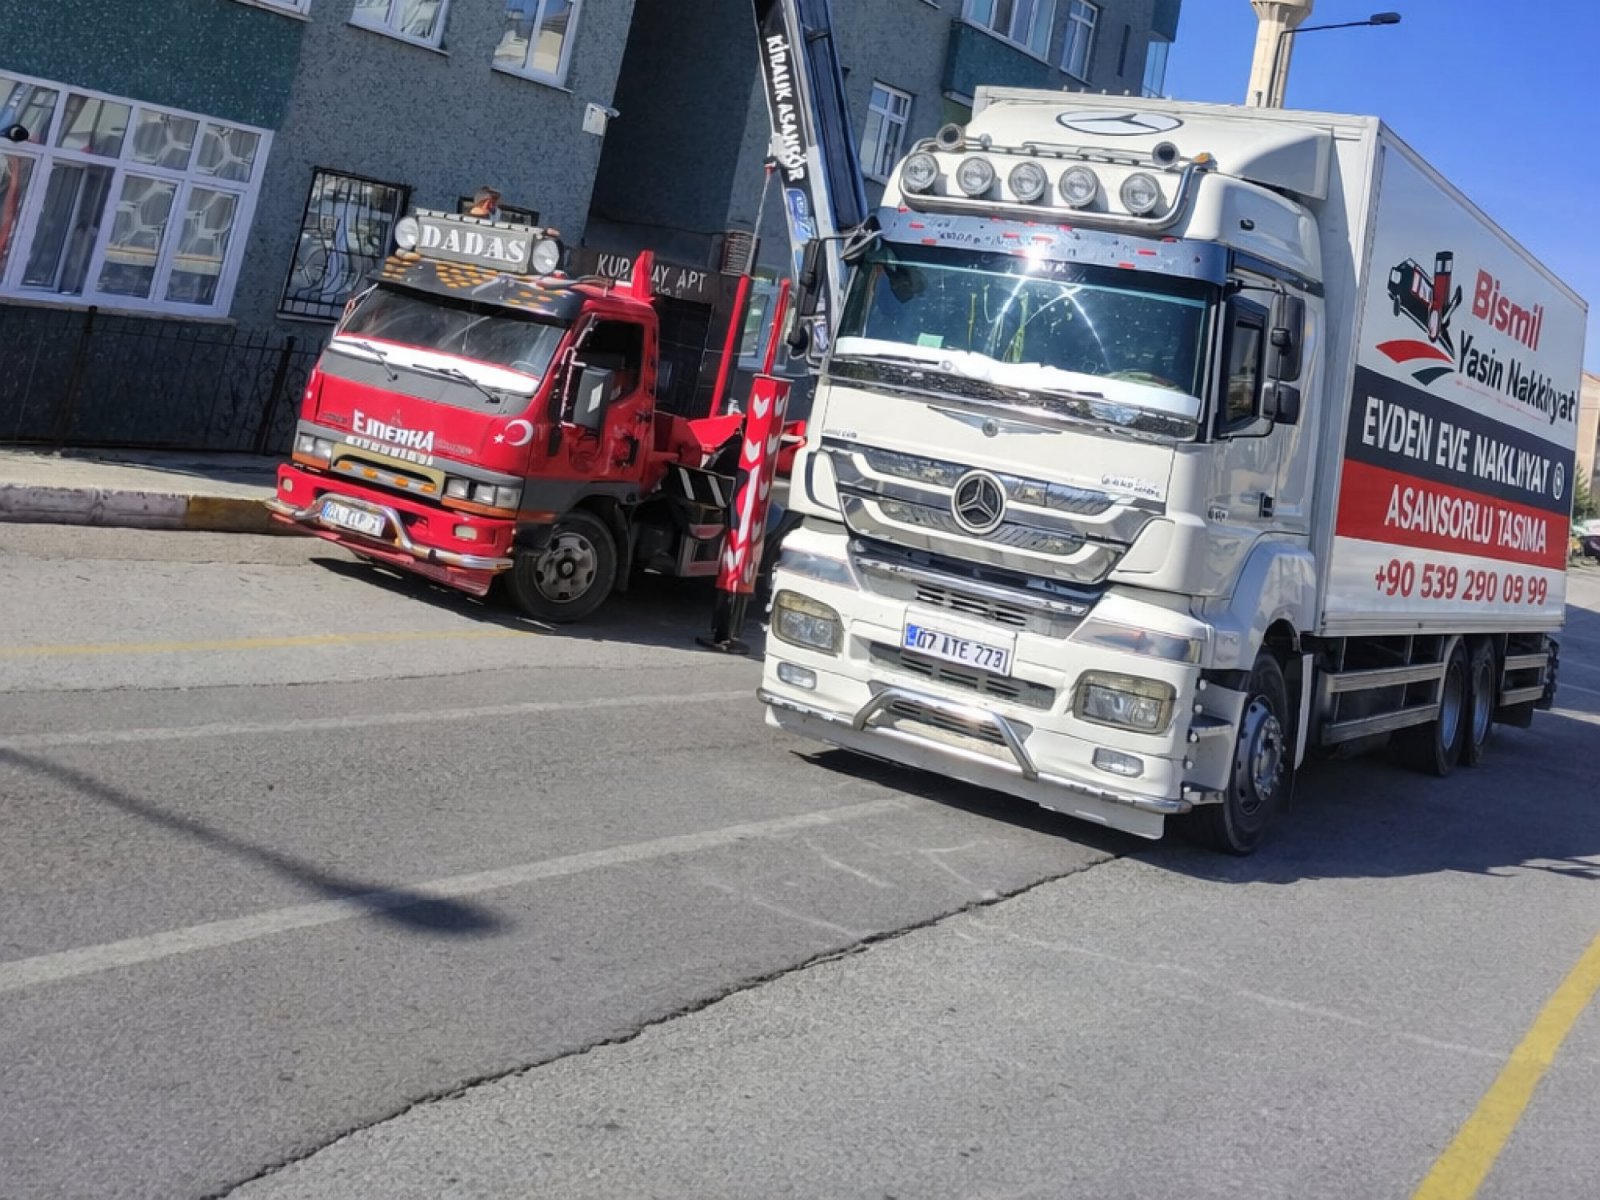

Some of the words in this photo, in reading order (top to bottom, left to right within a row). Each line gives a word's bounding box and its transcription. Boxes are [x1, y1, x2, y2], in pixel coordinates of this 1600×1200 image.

[420, 224, 527, 263] DADAS
[676, 268, 708, 294] APT
[1472, 268, 1543, 352] Bismil
[1459, 329, 1504, 392] Yasin
[1362, 396, 1433, 462] EVDEN
[1436, 421, 1470, 473] EVE
[1375, 559, 1415, 597] +90
[1420, 563, 1459, 600] 539
[1462, 569, 1498, 603] 290
[1527, 576, 1548, 606] 99
